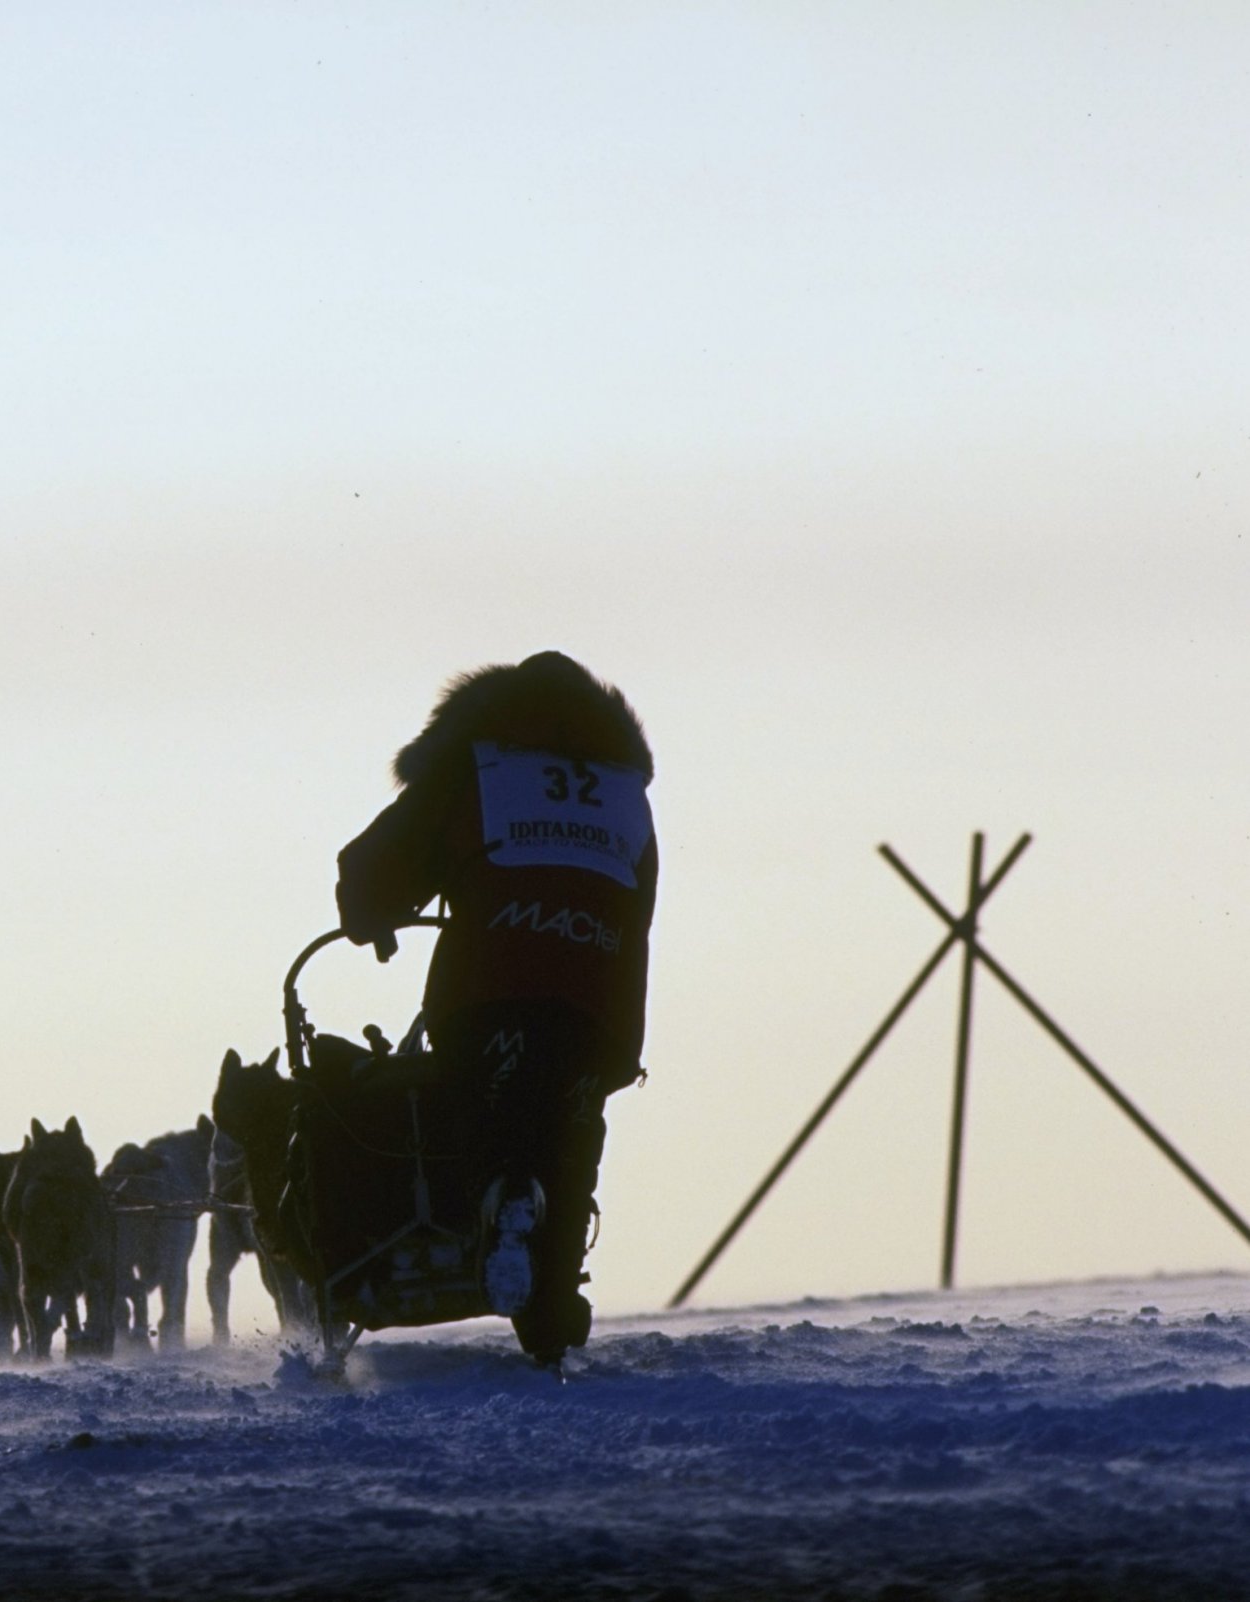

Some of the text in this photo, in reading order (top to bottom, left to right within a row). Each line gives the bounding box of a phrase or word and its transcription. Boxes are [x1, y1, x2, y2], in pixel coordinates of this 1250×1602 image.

[543, 765, 603, 808] 32
[509, 820, 610, 846] IDITAROD
[486, 902, 624, 954] MACtel
